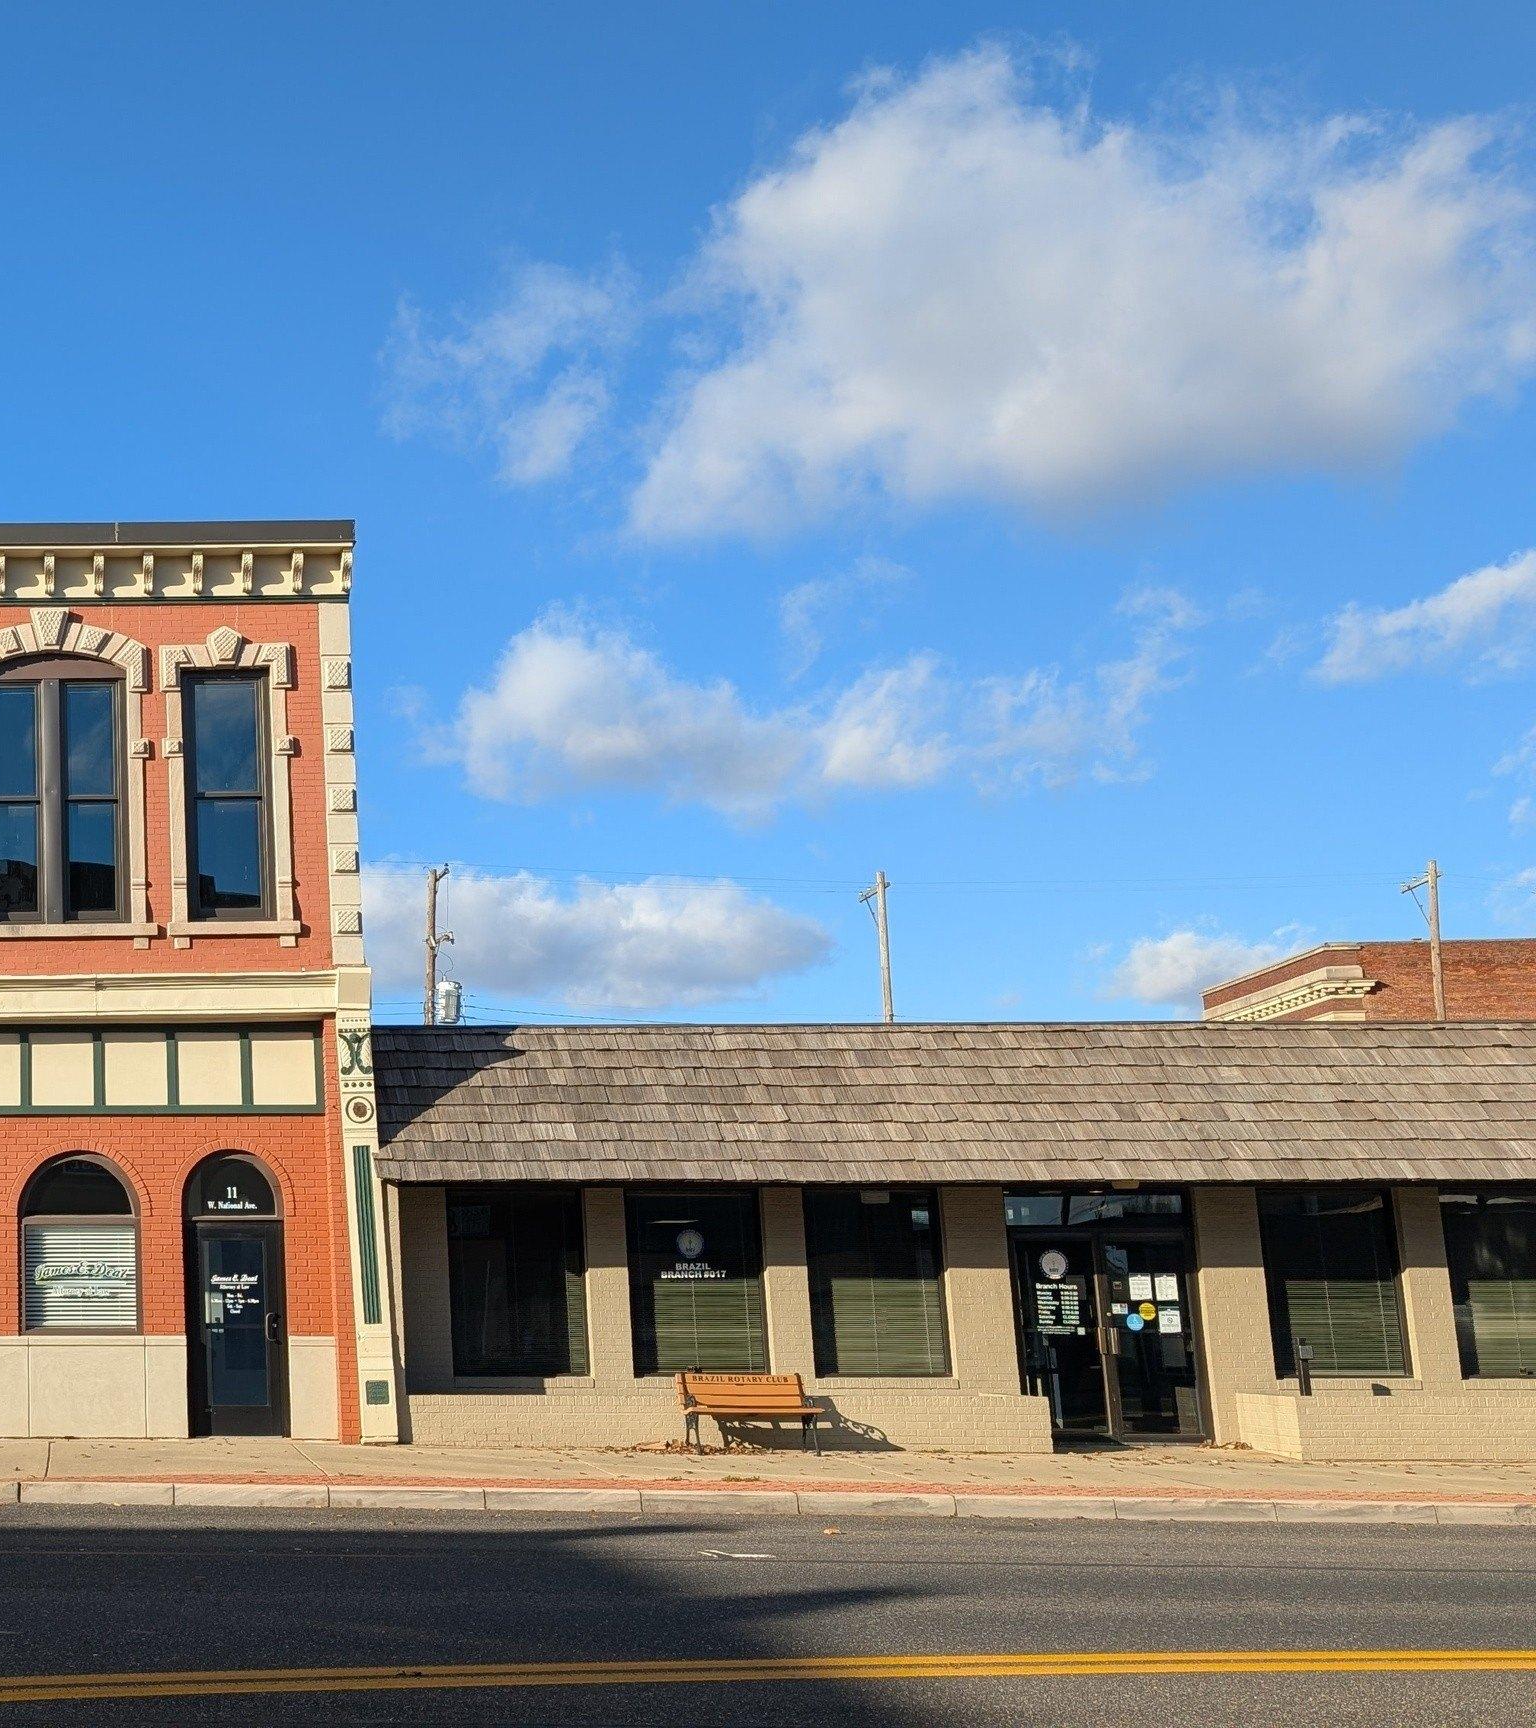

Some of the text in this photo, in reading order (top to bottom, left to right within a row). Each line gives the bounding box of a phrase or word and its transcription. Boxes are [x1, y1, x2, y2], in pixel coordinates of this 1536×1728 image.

[227, 1187, 237, 1198] 11
[207, 1201, 257, 1210] W. National Ave.
[35, 1265, 77, 1281] James
[661, 1270, 702, 1278] BRANCH
[692, 1375, 725, 1383] BRAZIL
[727, 1375, 763, 1383] ROTARY
